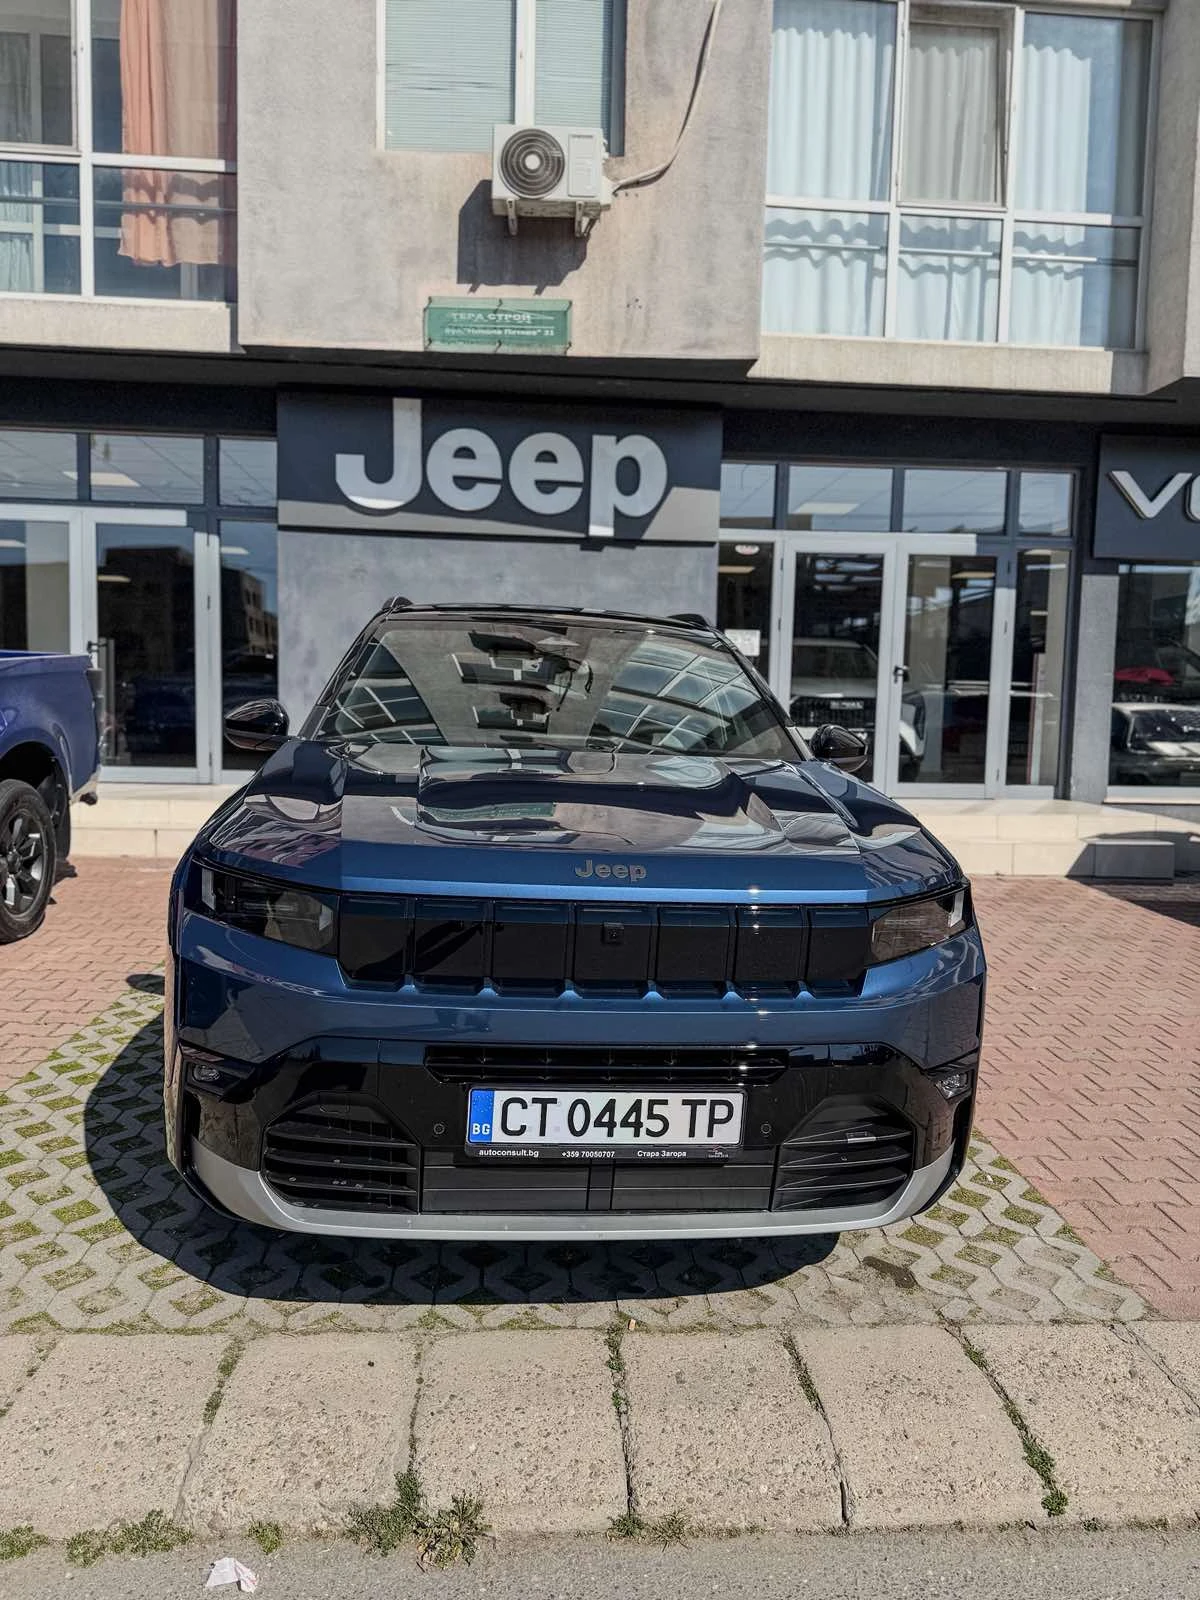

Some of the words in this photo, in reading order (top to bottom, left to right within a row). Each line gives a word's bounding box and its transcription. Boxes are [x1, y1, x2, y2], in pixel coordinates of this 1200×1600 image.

[335, 397, 668, 537] Jeep
[575, 859, 647, 882] Jeep
[500, 1097, 558, 1137] CT
[567, 1098, 670, 1138] 0445
[681, 1098, 735, 1138] TP
[472, 1123, 491, 1135] BG
[478, 1148, 539, 1158] autoconsult.bg
[561, 1150, 579, 1158] +359
[580, 1150, 616, 1158] 70050707
[636, 1149, 660, 1158] Стара
[661, 1150, 687, 1159] Загора
